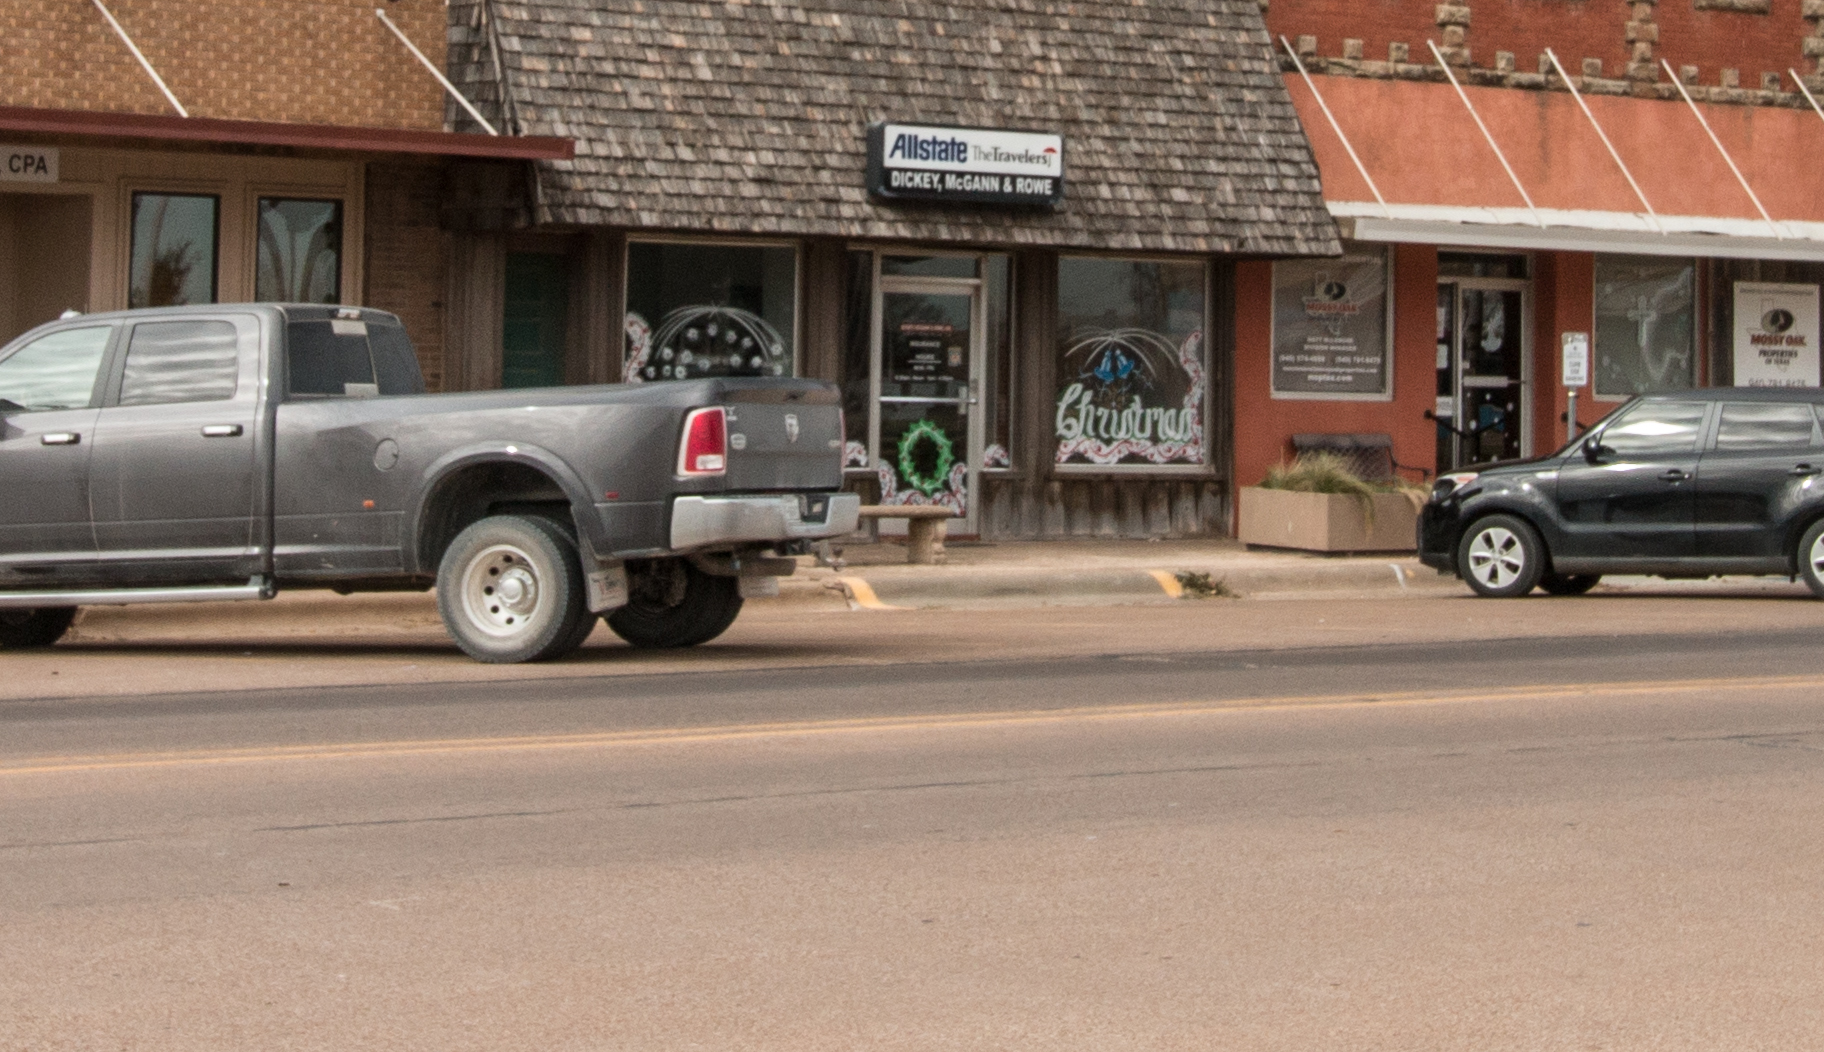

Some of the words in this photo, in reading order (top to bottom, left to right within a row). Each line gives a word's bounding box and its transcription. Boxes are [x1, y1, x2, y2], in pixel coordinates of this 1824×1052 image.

[889, 134, 968, 163] Allstate
[9, 154, 49, 175] CPA
[891, 171, 943, 192] DICKEY,
[946, 175, 999, 192] McGANN
[1003, 178, 1013, 193] &
[1016, 178, 1053, 195] ROWE
[1750, 334, 1785, 346] MOSSY
[1786, 335, 1806, 346] OAK
[1759, 349, 1798, 358] PROPERTIES
[1056, 382, 1196, 441] Christmas
